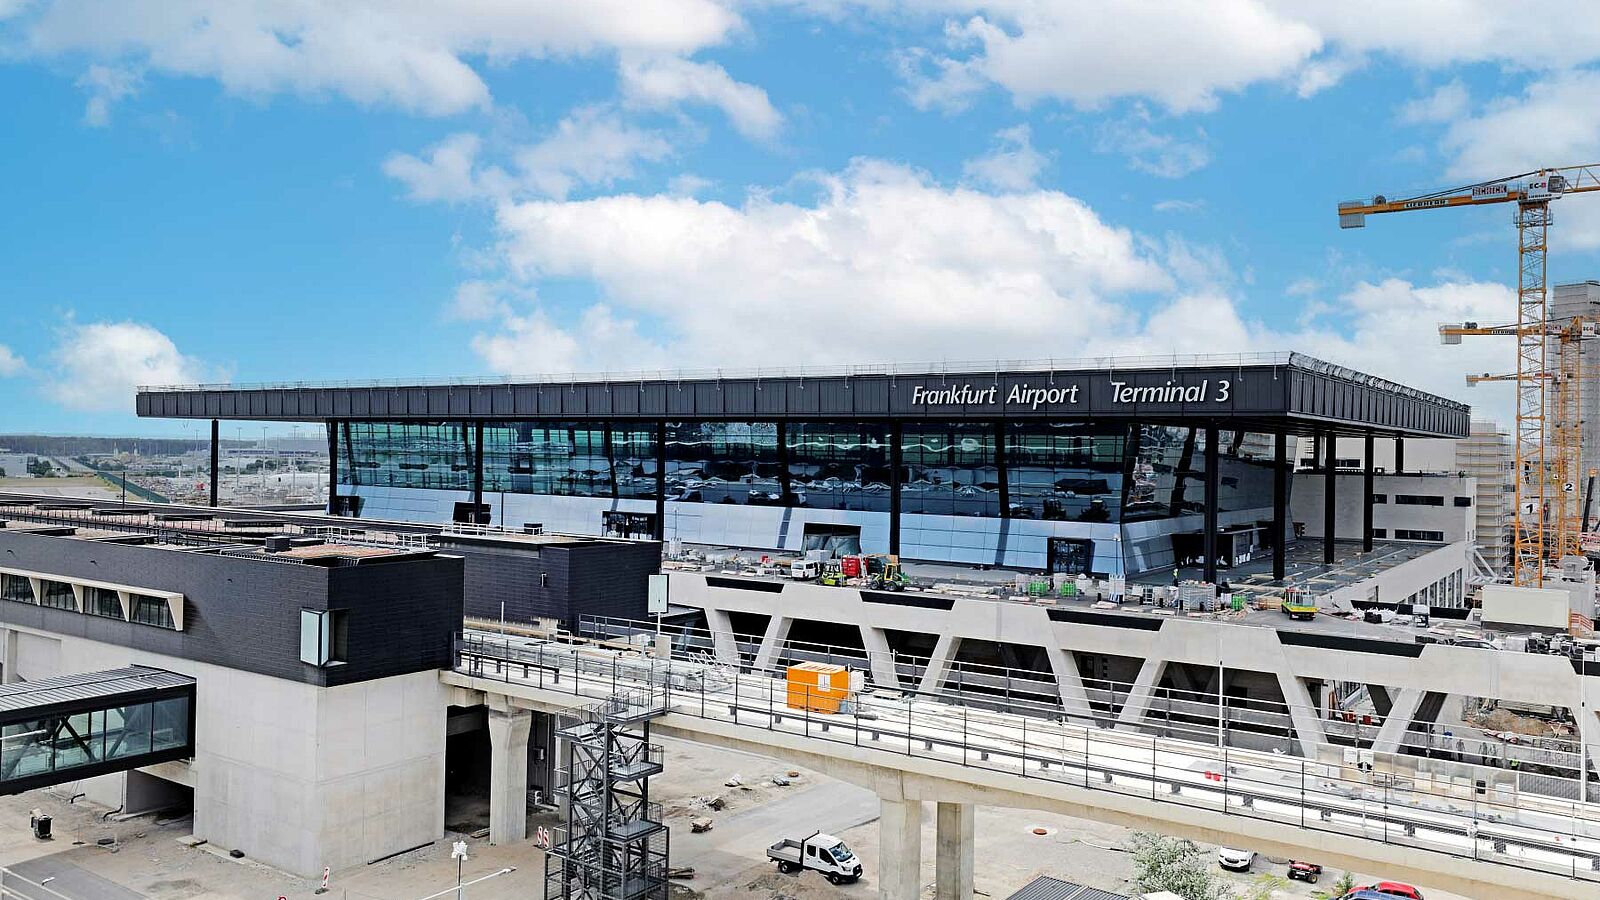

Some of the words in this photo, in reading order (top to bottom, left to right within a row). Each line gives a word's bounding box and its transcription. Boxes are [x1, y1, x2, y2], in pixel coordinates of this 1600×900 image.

[912, 383, 997, 405] Frankfurt
[1006, 383, 1078, 410] Airport
[1110, 379, 1208, 403] Terminal
[1215, 380, 1230, 402] 3
[1565, 483, 1572, 491] 2
[1525, 503, 1533, 513] 1
